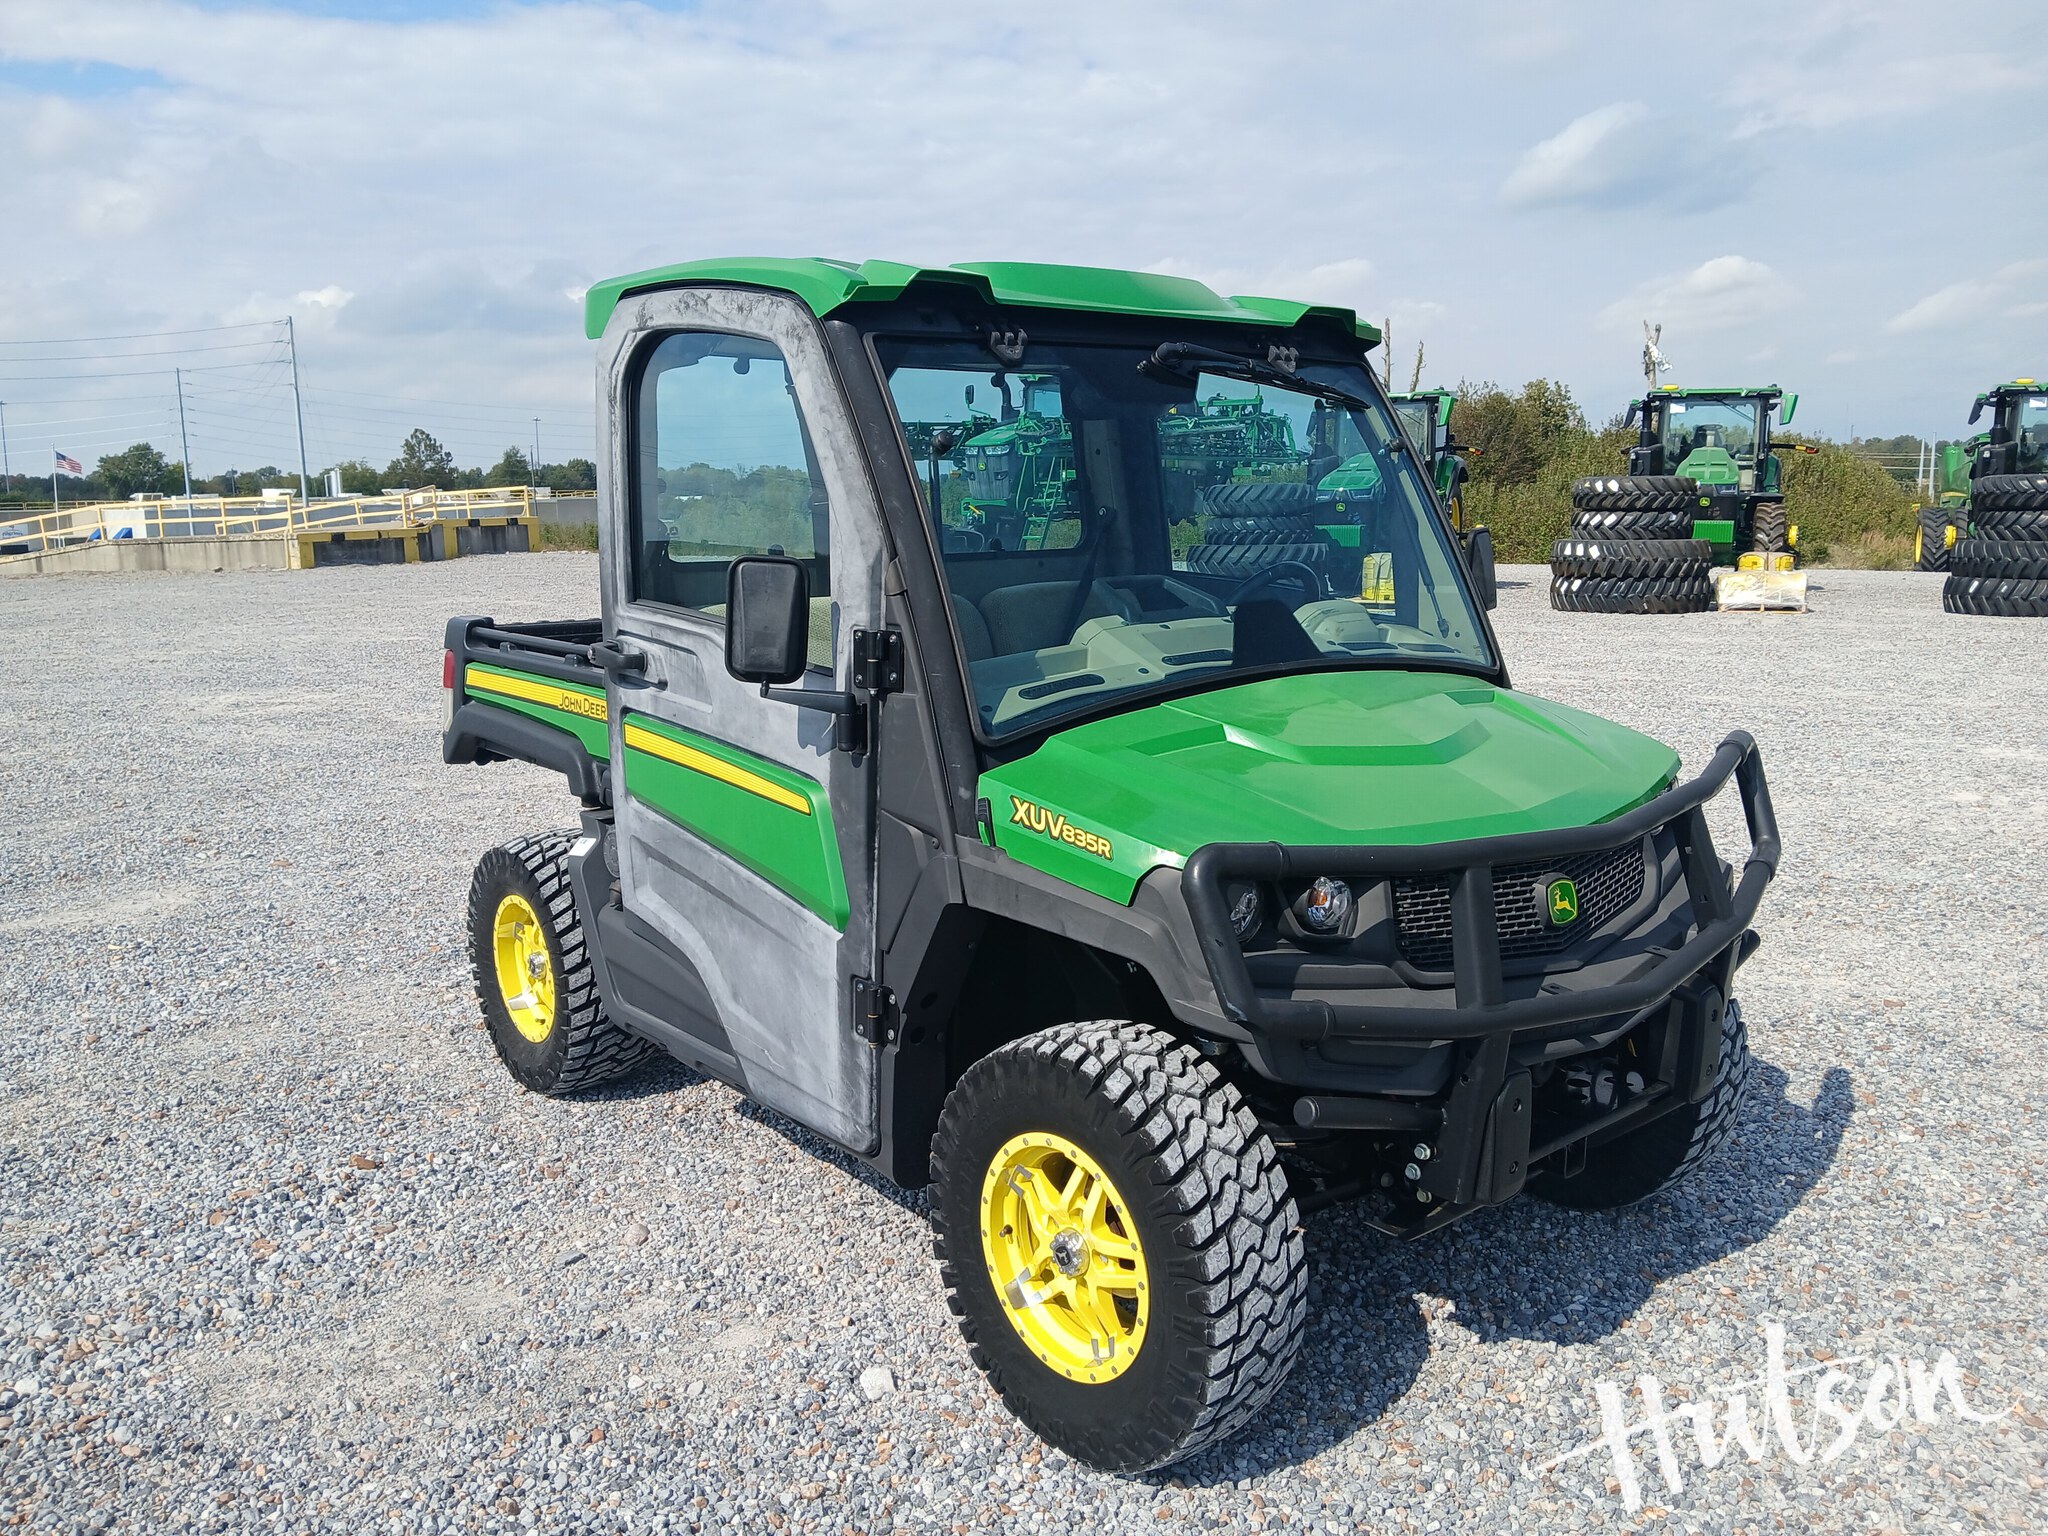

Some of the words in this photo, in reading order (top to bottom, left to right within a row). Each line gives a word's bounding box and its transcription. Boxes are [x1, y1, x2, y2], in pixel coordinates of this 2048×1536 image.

[559, 693, 582, 713] JOHN
[583, 697, 607, 718] DEER
[1010, 795, 1113, 862] XUV835R
